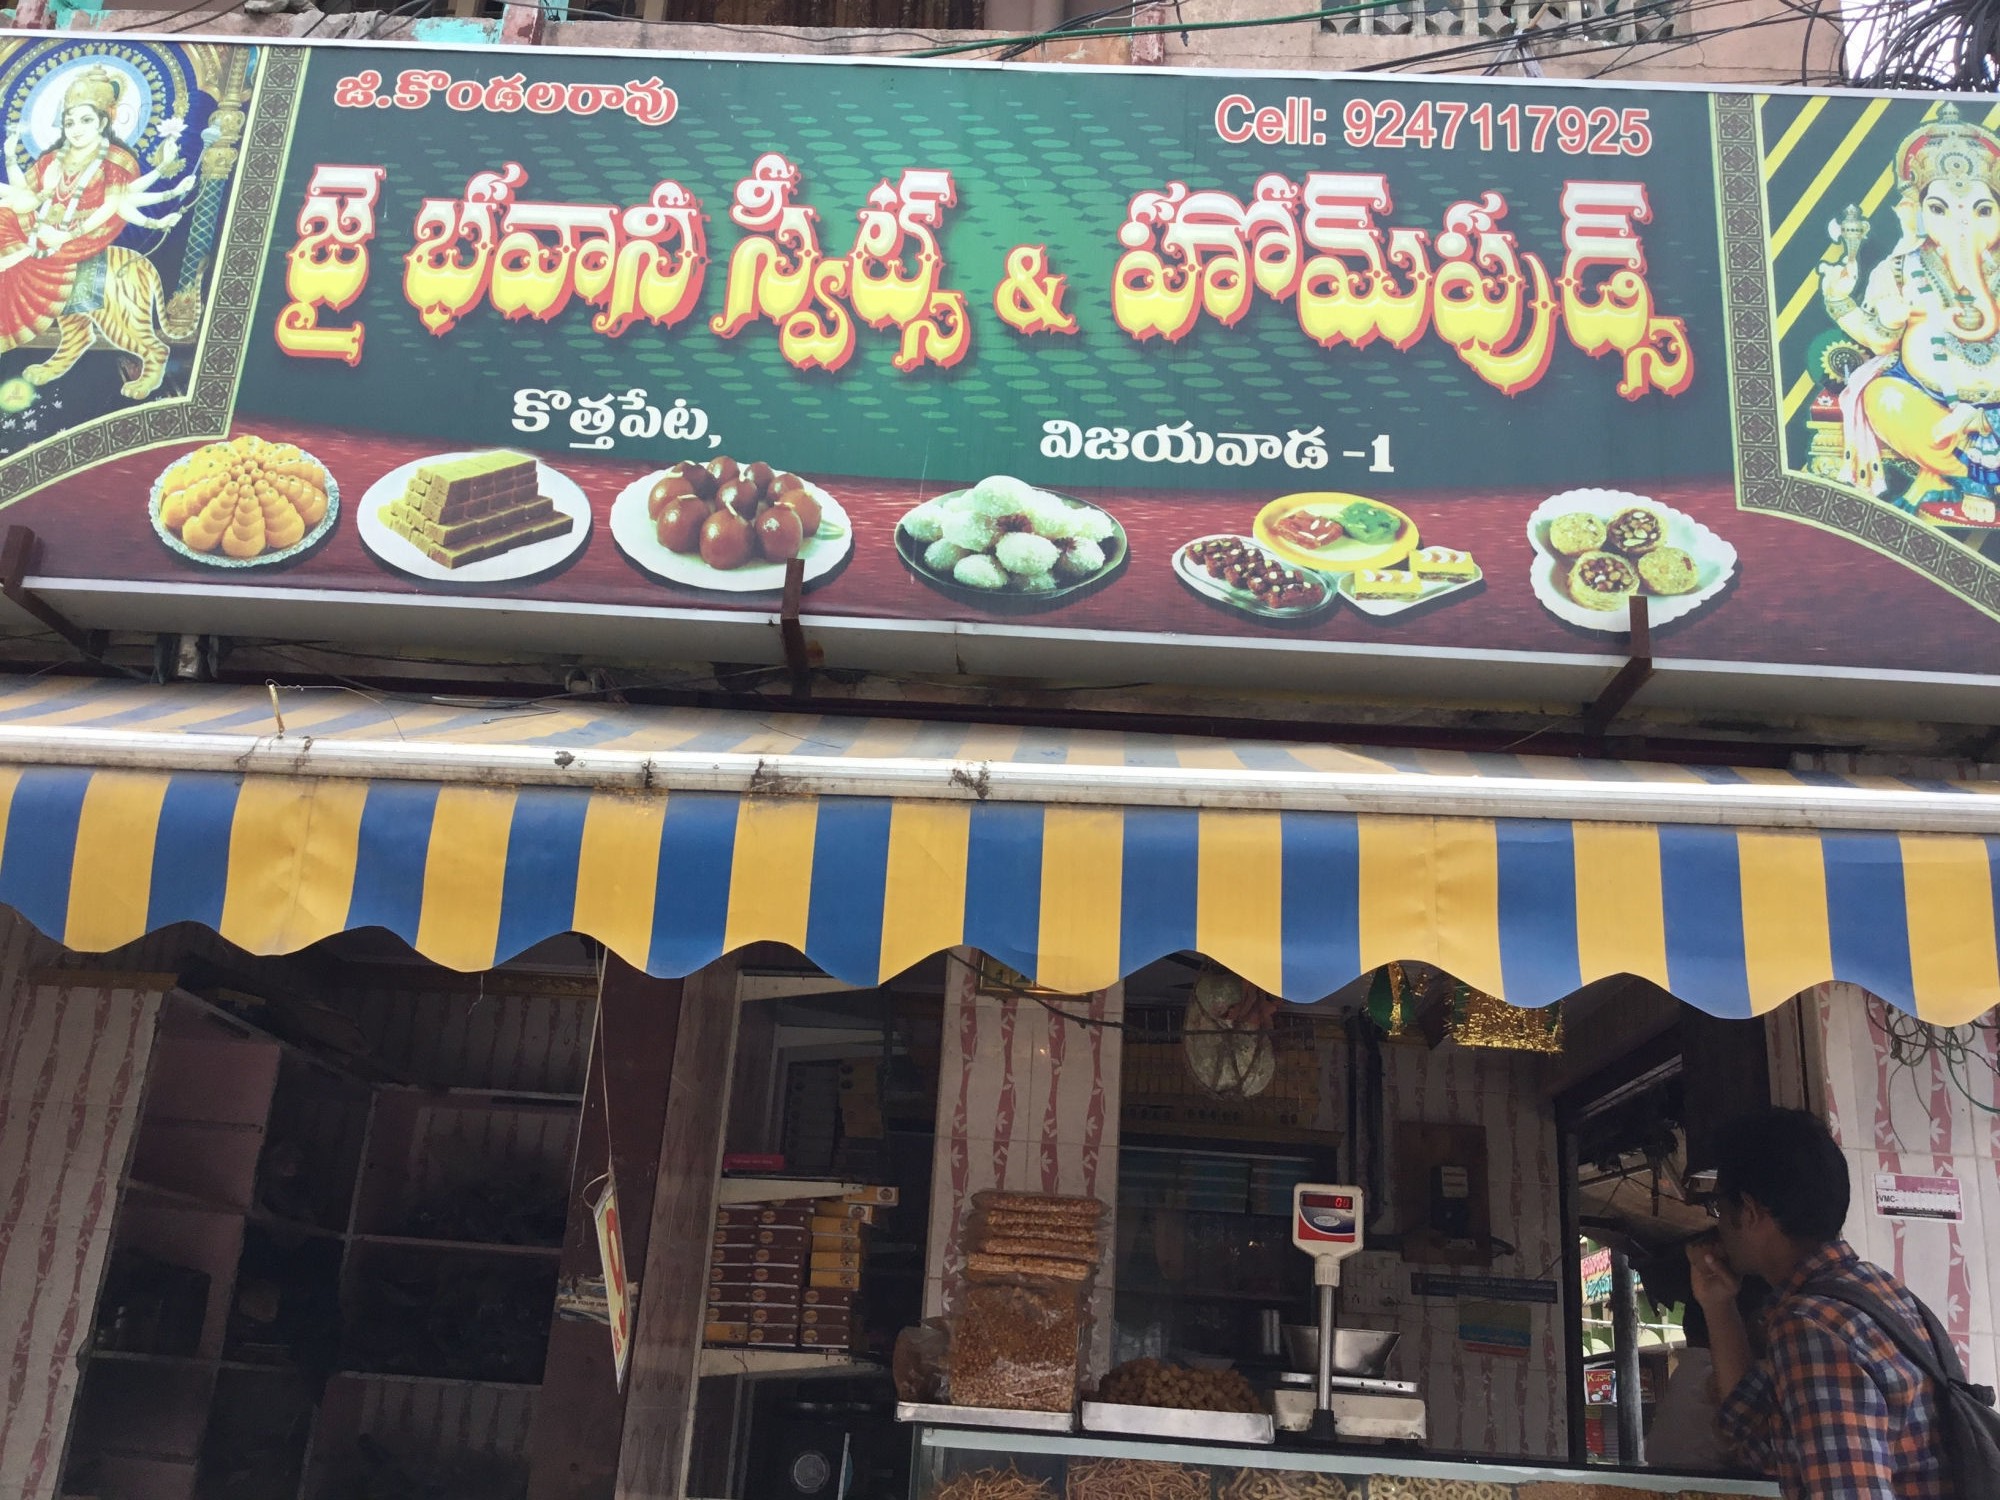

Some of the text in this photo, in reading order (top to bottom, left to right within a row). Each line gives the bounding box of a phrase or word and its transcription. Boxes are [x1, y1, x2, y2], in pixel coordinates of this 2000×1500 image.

[334, 69, 679, 126] జి.కొండలరావు
[1215, 94, 1652, 156] Cell: 9247117925
[275, 163, 387, 367] జై
[709, 151, 972, 374] స్వీట్స్
[996, 244, 1080, 335] &
[511, 388, 722, 450] కొత్తపేట,
[1039, 420, 1329, 470] విజయవాడ
